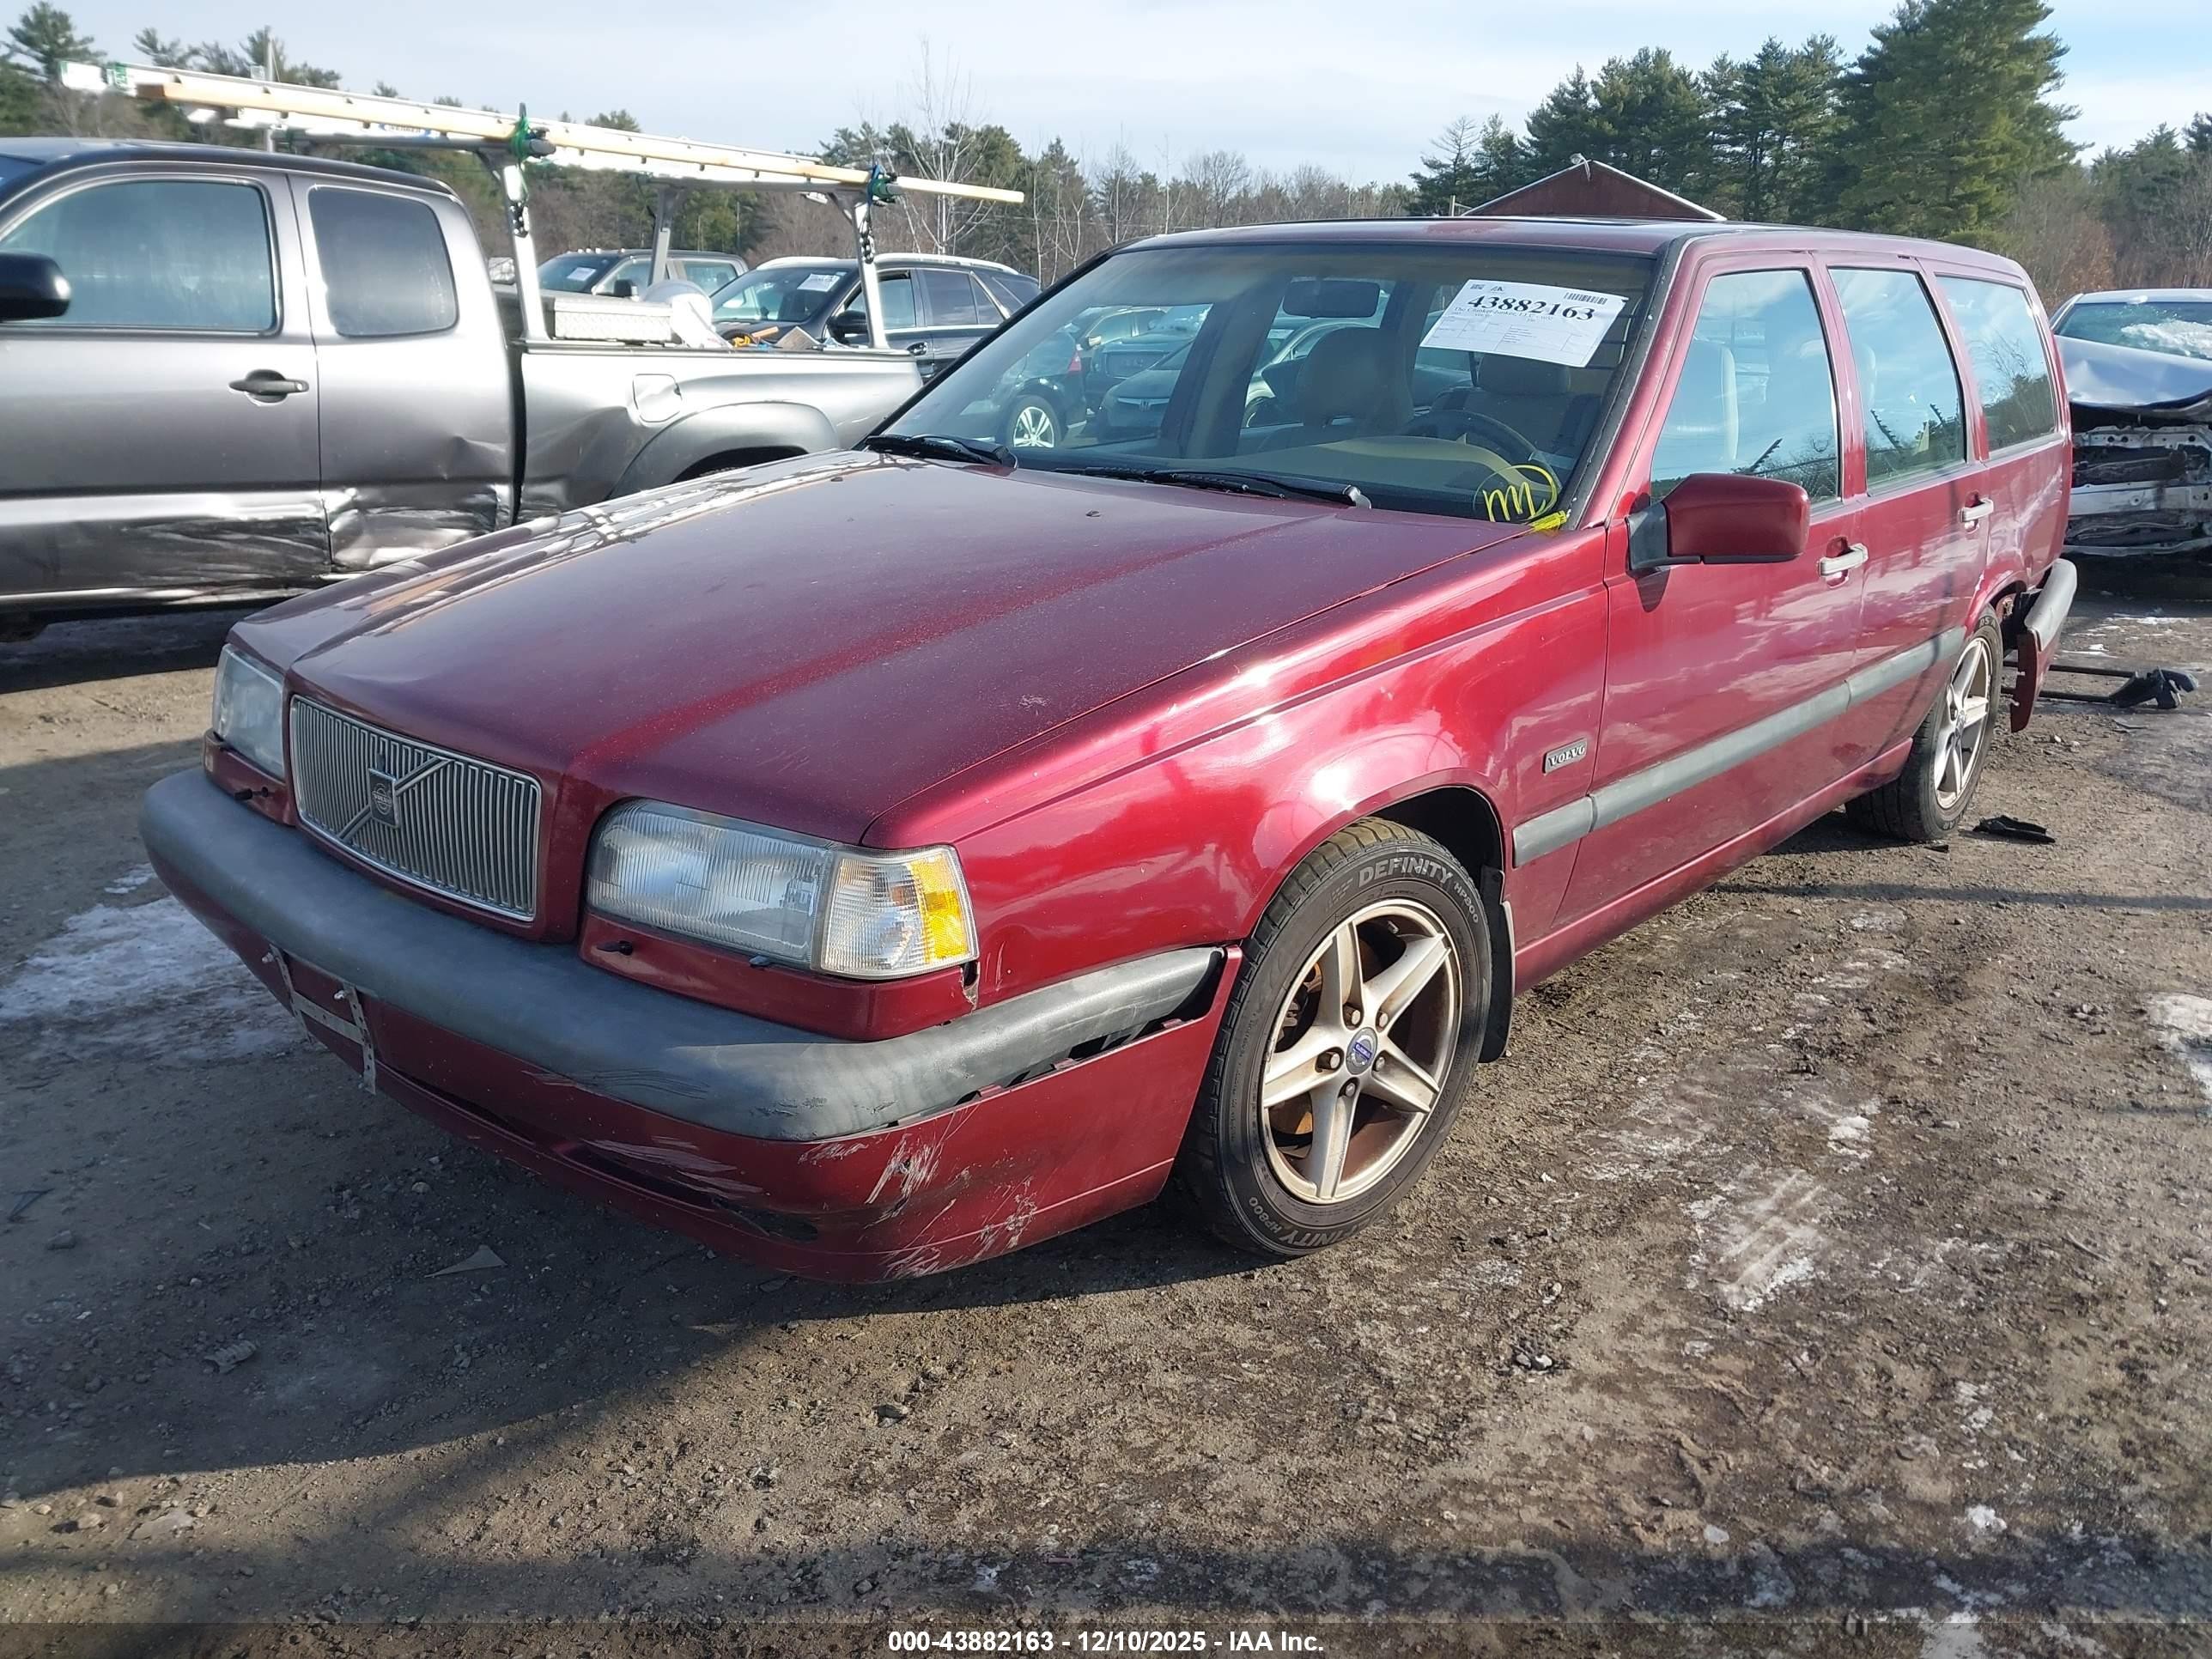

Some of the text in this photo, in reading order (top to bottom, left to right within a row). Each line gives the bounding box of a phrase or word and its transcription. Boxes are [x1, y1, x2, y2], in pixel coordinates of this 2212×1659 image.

[1468, 295, 1595, 321] 43882163
[1548, 744, 1586, 767] VOLVO
[1358, 857, 1479, 924] DEFINITY HP800
[1249, 1196, 1282, 1234] HP800
